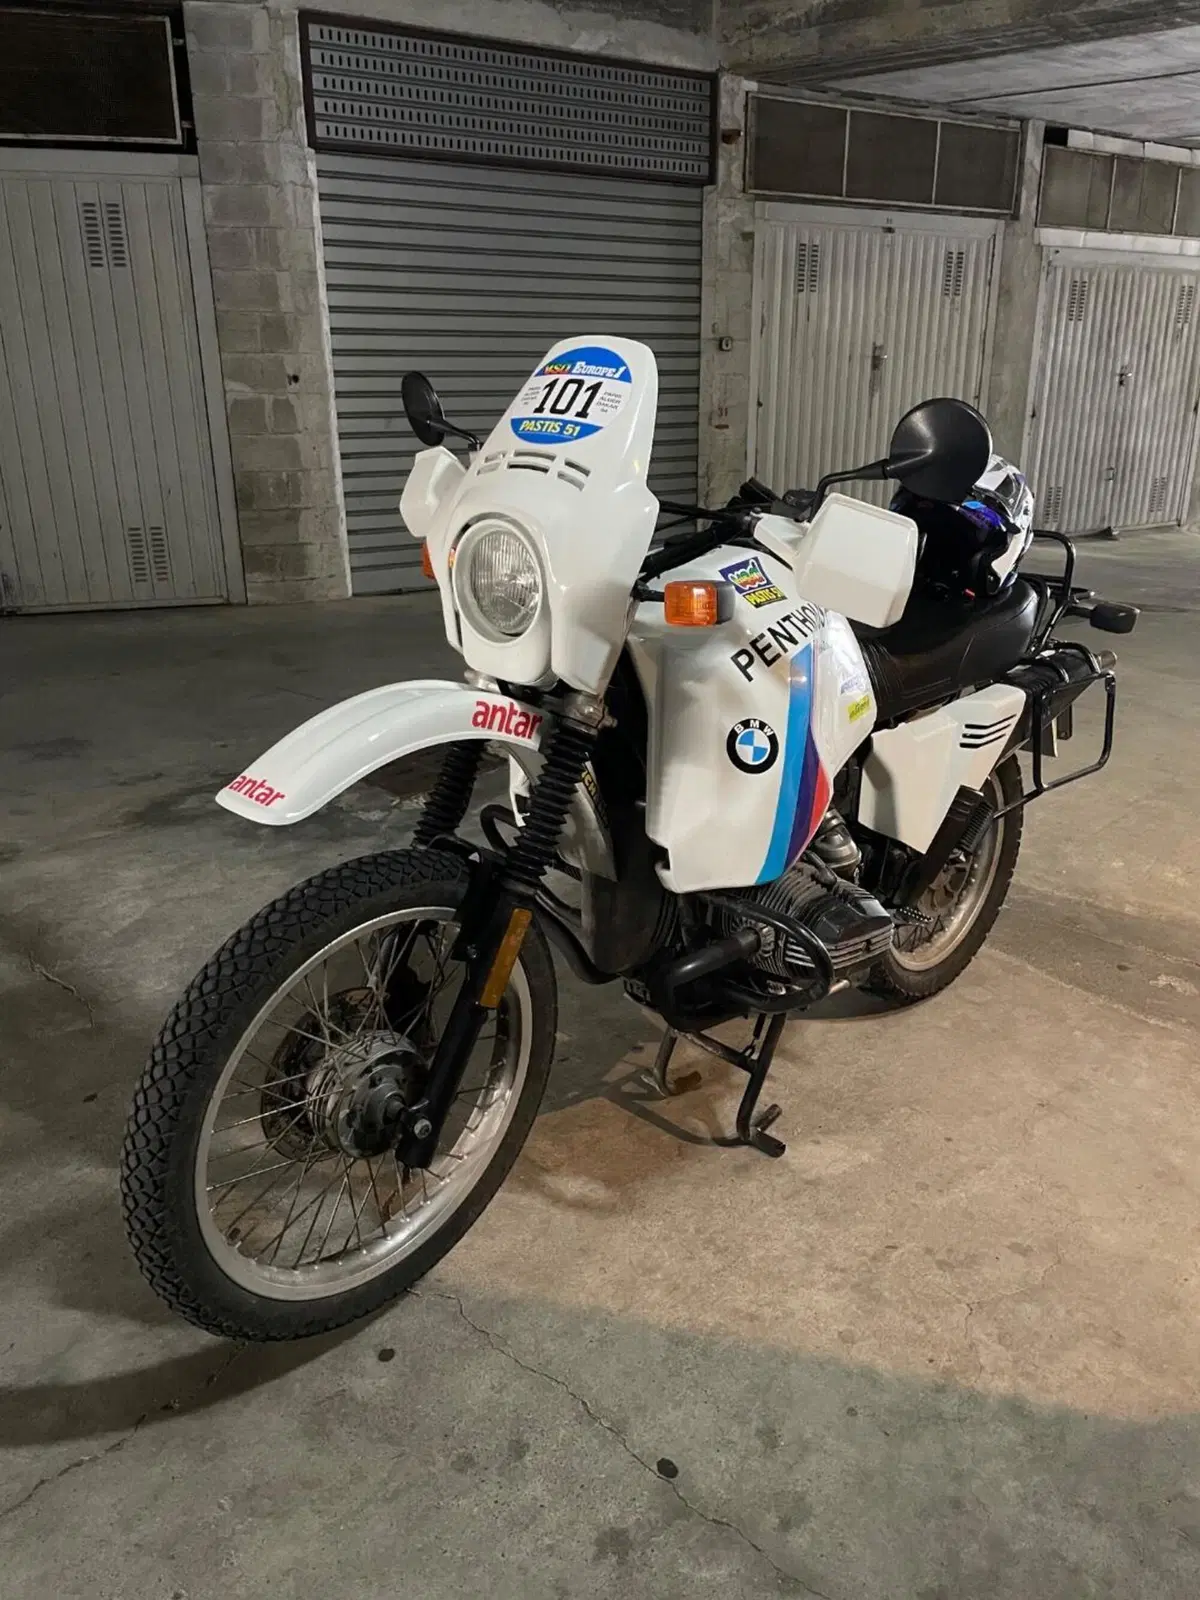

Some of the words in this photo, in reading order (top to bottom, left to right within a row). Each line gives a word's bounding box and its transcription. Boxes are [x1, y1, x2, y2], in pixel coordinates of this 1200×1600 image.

[533, 378, 603, 419] 101
[519, 420, 562, 433] PASTIS
[563, 424, 581, 437] 51
[730, 601, 827, 683] PENTHO
[471, 700, 543, 740] antar
[733, 719, 774, 737] BMW
[228, 775, 286, 807] antar
